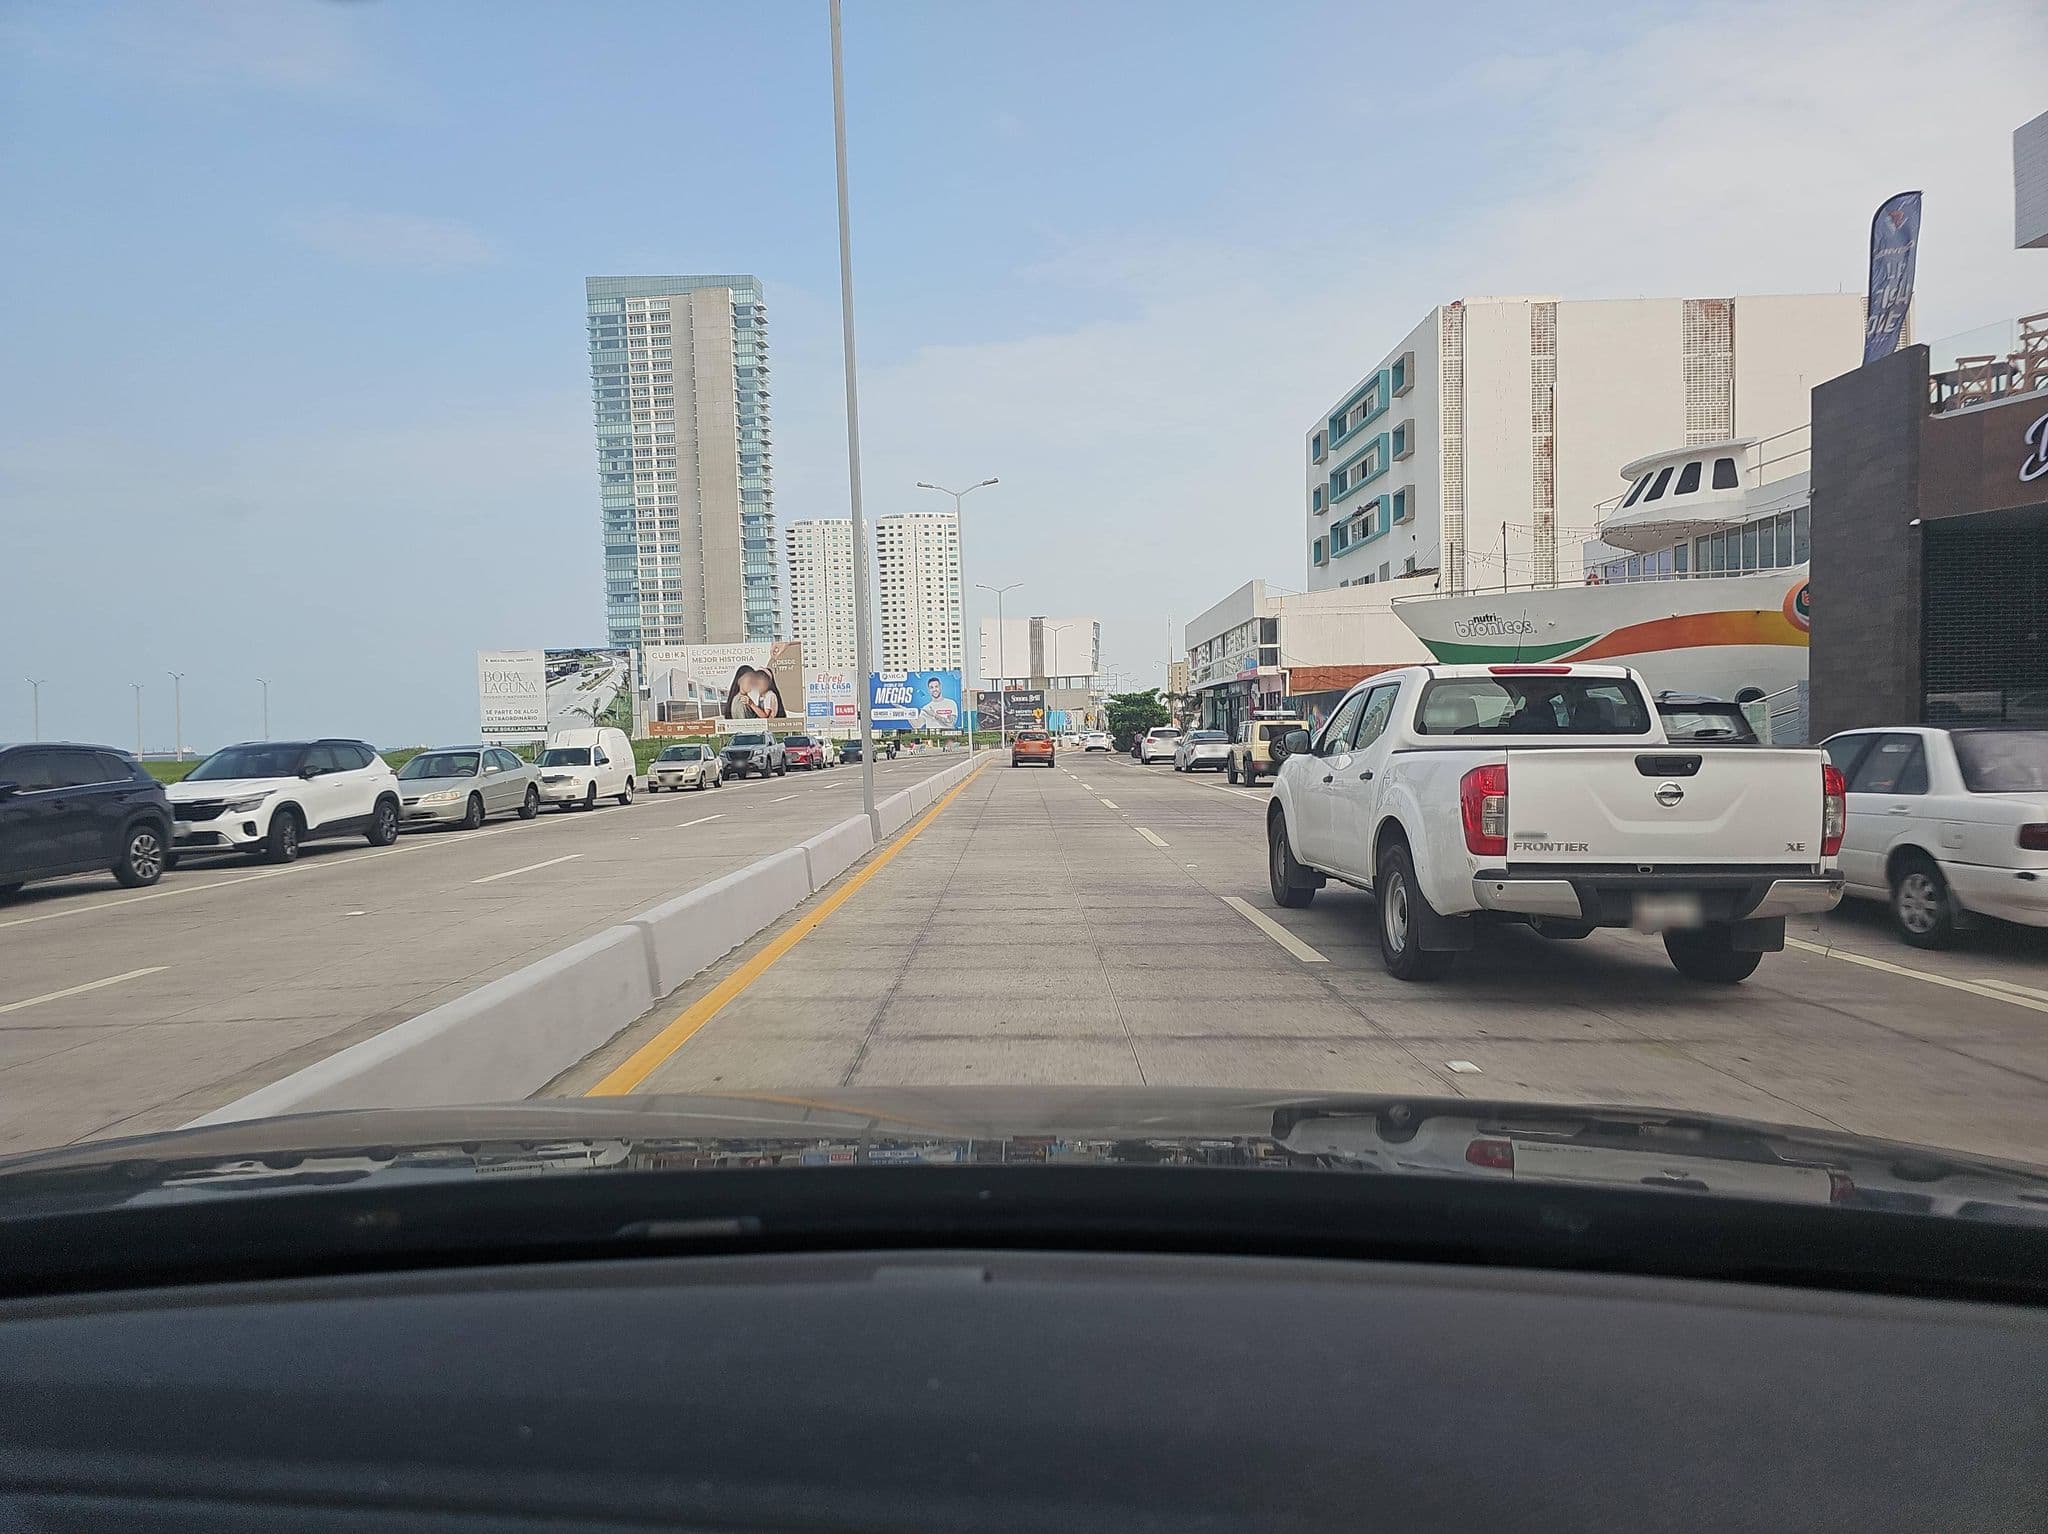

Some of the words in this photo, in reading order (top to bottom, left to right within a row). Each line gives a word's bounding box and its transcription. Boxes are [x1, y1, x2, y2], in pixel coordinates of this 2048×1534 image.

[1473, 612, 1497, 624] nutri
[1454, 617, 1534, 638] bionicos
[651, 650, 686, 659] CUBIKA
[691, 649, 701, 657] EL
[701, 648, 743, 656] COMIENZO
[744, 647, 755, 655] DE
[719, 655, 755, 663] HISTORIA
[484, 671, 522, 682] BOKA
[817, 673, 826, 683] El
[484, 681, 538, 693] LAGUNA
[831, 682, 851, 690] CASA
[875, 686, 914, 705] MEGAS
[1513, 842, 1589, 852] FRONTIER
[1785, 842, 1806, 852] XE
